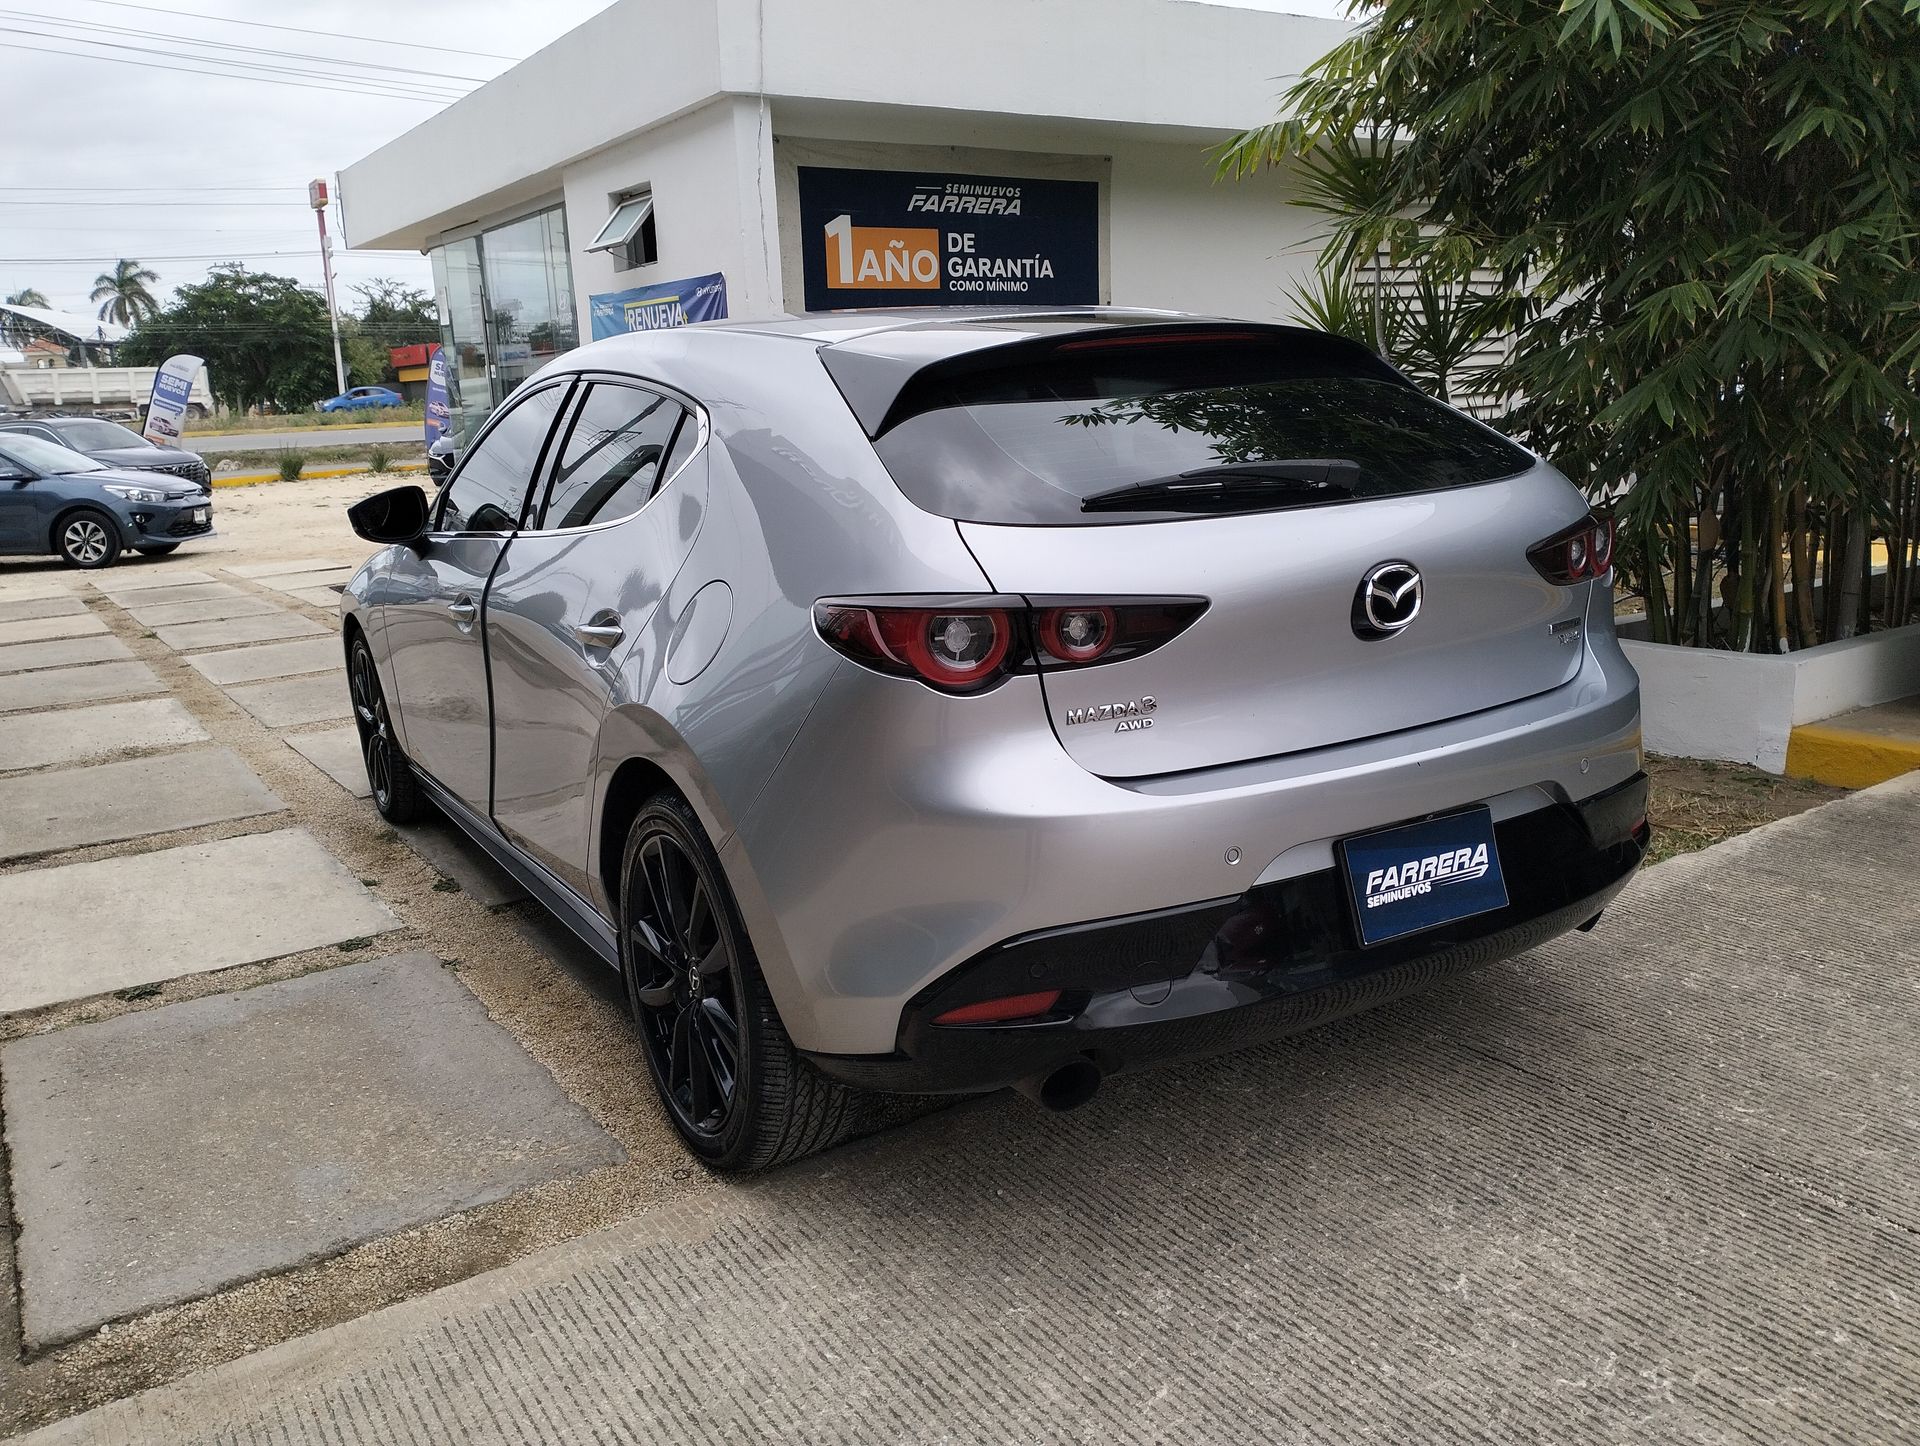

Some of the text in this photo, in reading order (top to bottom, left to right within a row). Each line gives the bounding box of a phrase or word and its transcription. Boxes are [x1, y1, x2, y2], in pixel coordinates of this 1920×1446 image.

[945, 183, 1021, 198] SEMINUEVOS
[907, 194, 1021, 216] FARRERA
[824, 214, 939, 284] 1 AÑO
[947, 232, 975, 254] DE
[947, 254, 1054, 279] GARANTÍA
[949, 278, 1029, 293] COMO MÍNIMO
[627, 302, 684, 331] RENUEVA
[160, 374, 187, 390] SEMI
[1114, 717, 1154, 733] AWD
[1366, 843, 1489, 895] FARRERA
[1367, 882, 1432, 908] SEMINUEVOS
